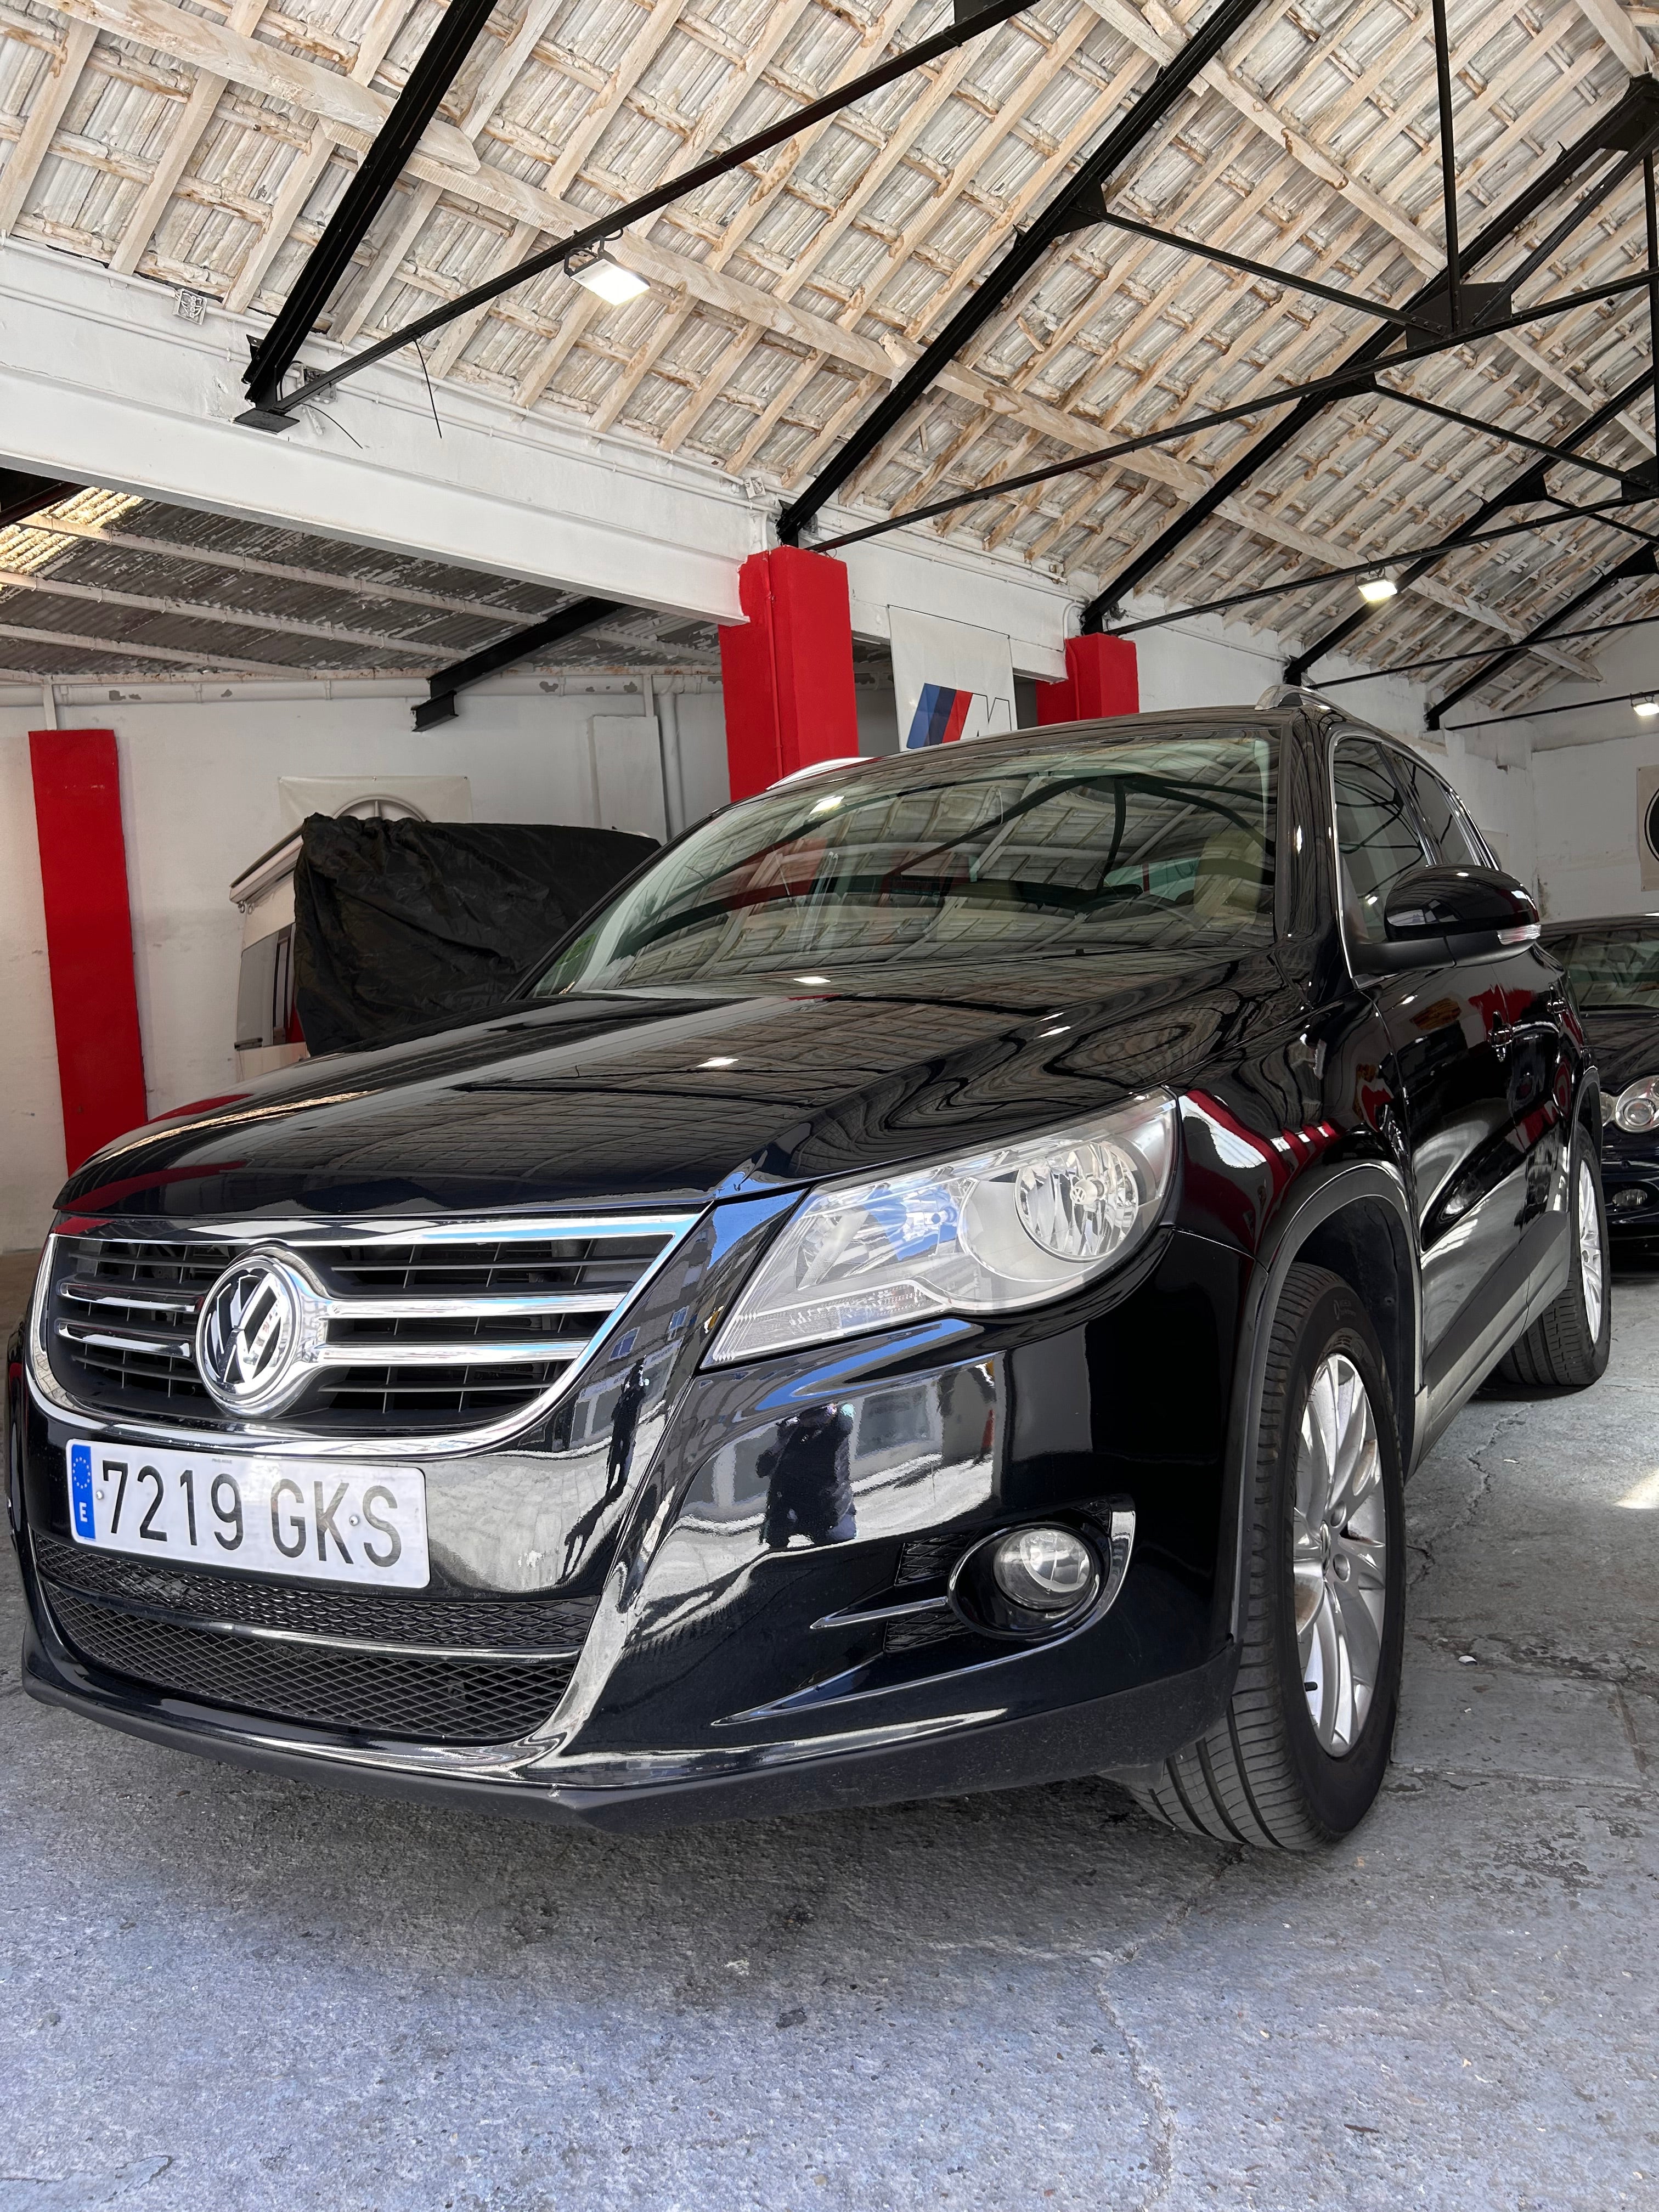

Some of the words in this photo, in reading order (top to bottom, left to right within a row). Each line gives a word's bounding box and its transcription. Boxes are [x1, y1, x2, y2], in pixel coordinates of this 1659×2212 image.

[201, 1261, 295, 1400] VW
[80, 1502, 88, 1522] E
[103, 1460, 244, 1551] 7219
[271, 1479, 402, 1567] GKS
